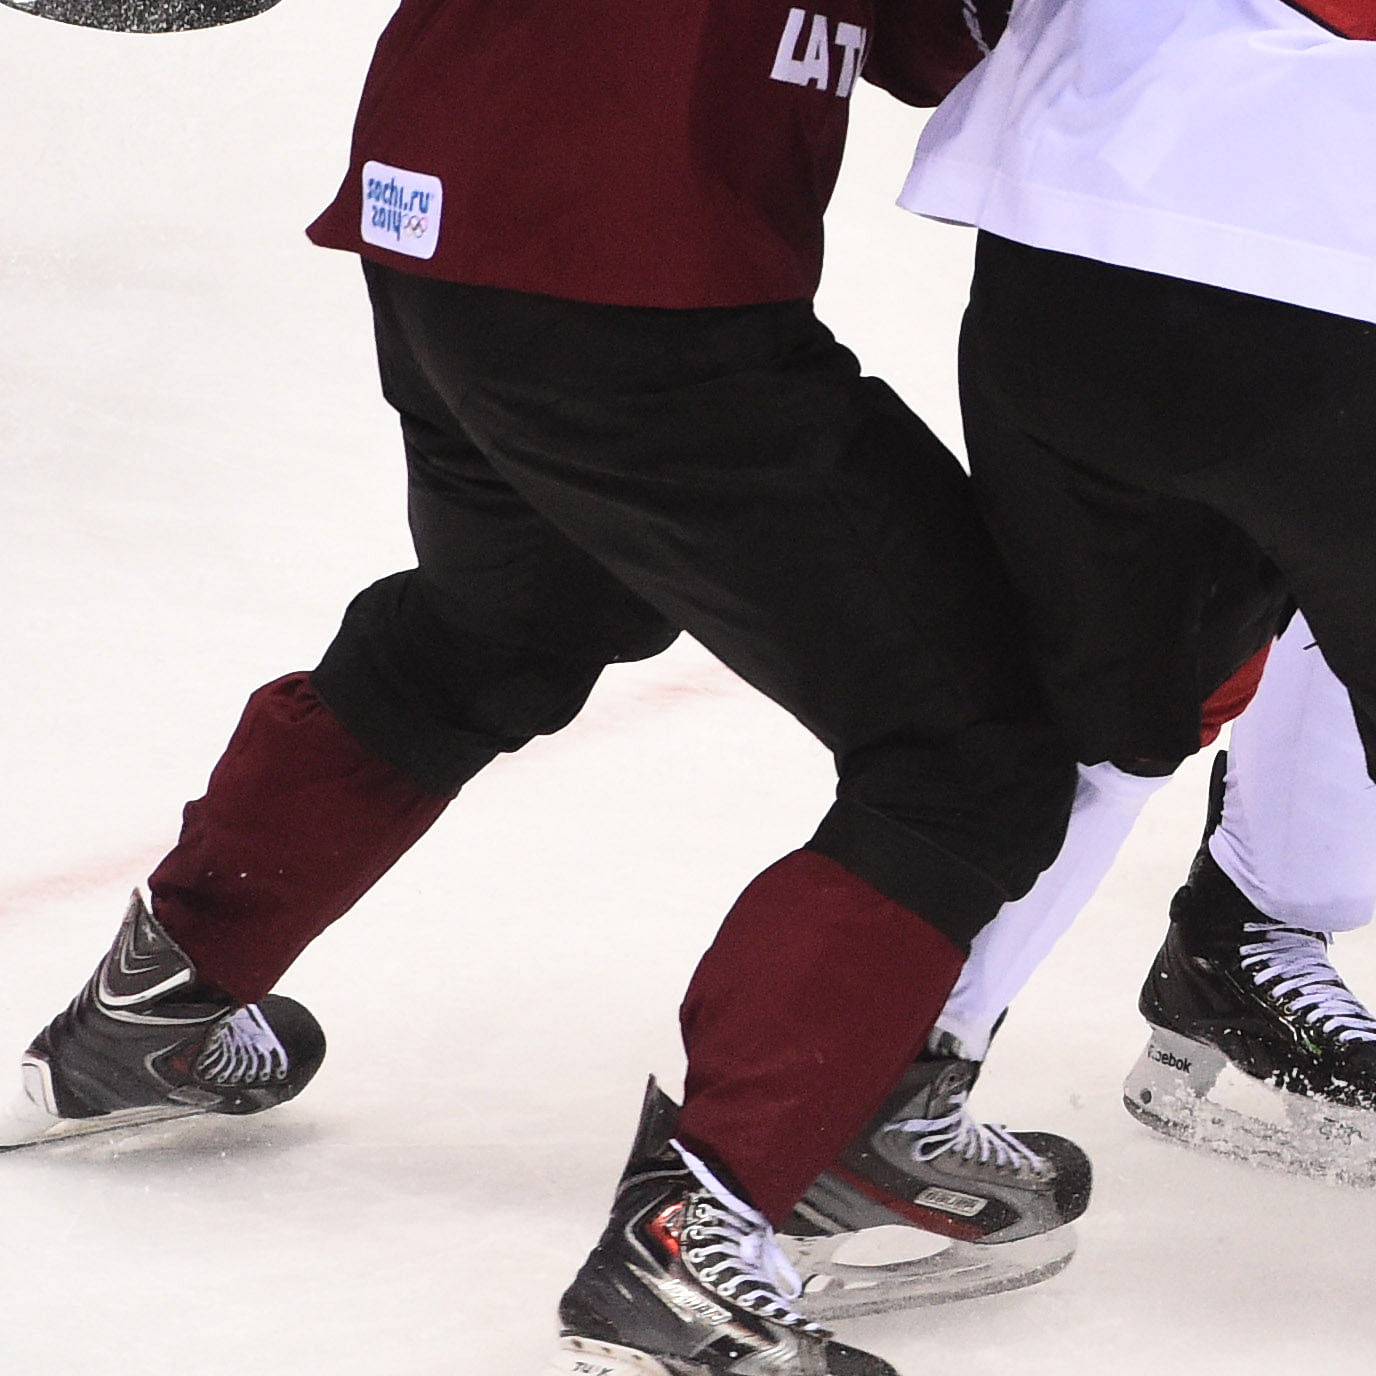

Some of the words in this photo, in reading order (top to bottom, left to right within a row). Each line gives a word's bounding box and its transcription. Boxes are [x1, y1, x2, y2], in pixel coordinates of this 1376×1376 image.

[770, 7, 868, 88] LAT
[366, 176, 431, 215] sochi.ru
[371, 205, 402, 242] 2014
